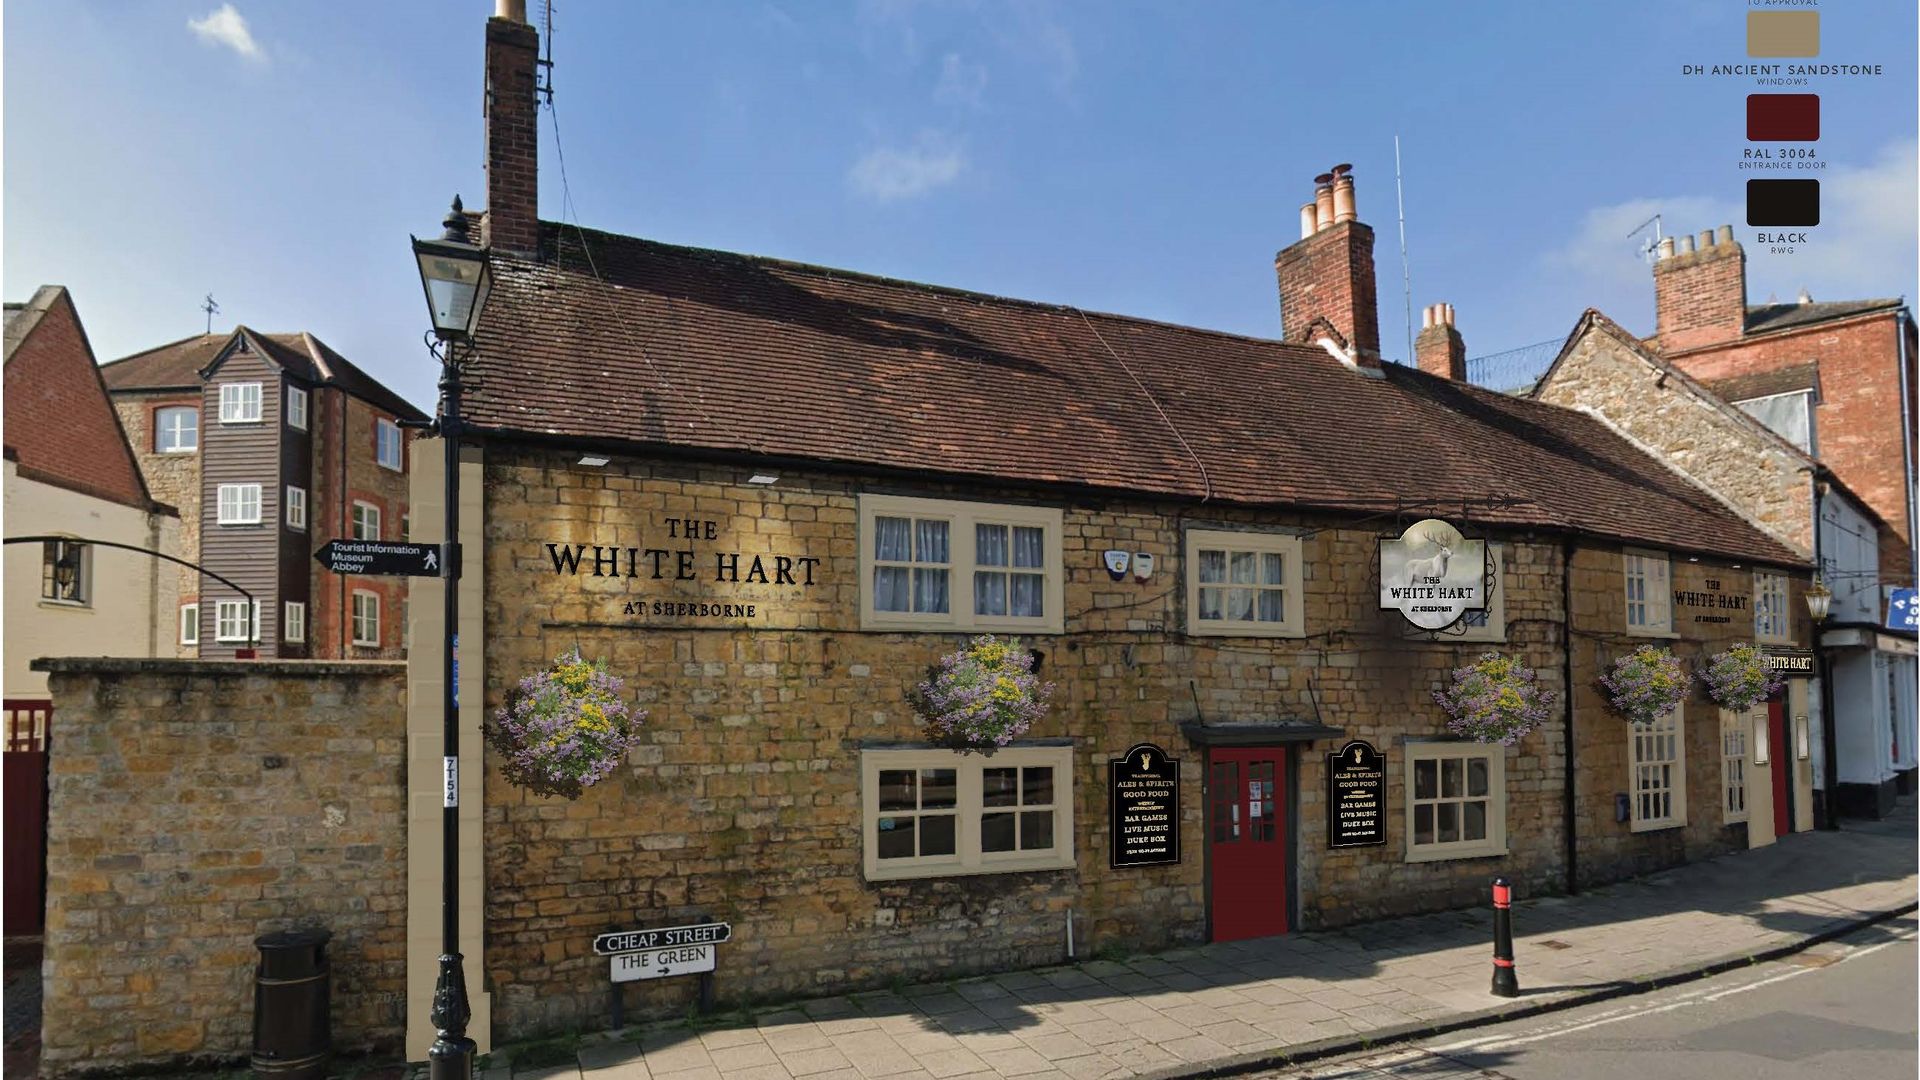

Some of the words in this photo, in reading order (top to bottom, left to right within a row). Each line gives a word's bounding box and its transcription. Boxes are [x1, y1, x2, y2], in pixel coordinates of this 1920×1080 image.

[665, 518, 718, 540] THE
[332, 542, 365, 552] Tourist
[366, 544, 420, 555] Information
[331, 552, 373, 562] Museum
[546, 543, 696, 581] WHITE
[715, 552, 820, 586] HART
[331, 562, 365, 573] Abbey
[1423, 576, 1440, 585] THE
[1391, 588, 1434, 599] WHITE
[1439, 588, 1473, 599] HART
[1675, 590, 1715, 608] WHITE
[1718, 594, 1747, 610] HART
[624, 601, 646, 615] AT
[653, 602, 756, 618] SHERBORNE
[1790, 657, 1811, 670] HART
[446, 759, 456, 801] 7T54
[1150, 835, 1166, 843] BOX
[607, 933, 658, 950] CHEAP
[666, 927, 720, 944] STREET
[620, 954, 649, 969] THE
[657, 947, 706, 965] GREEN
